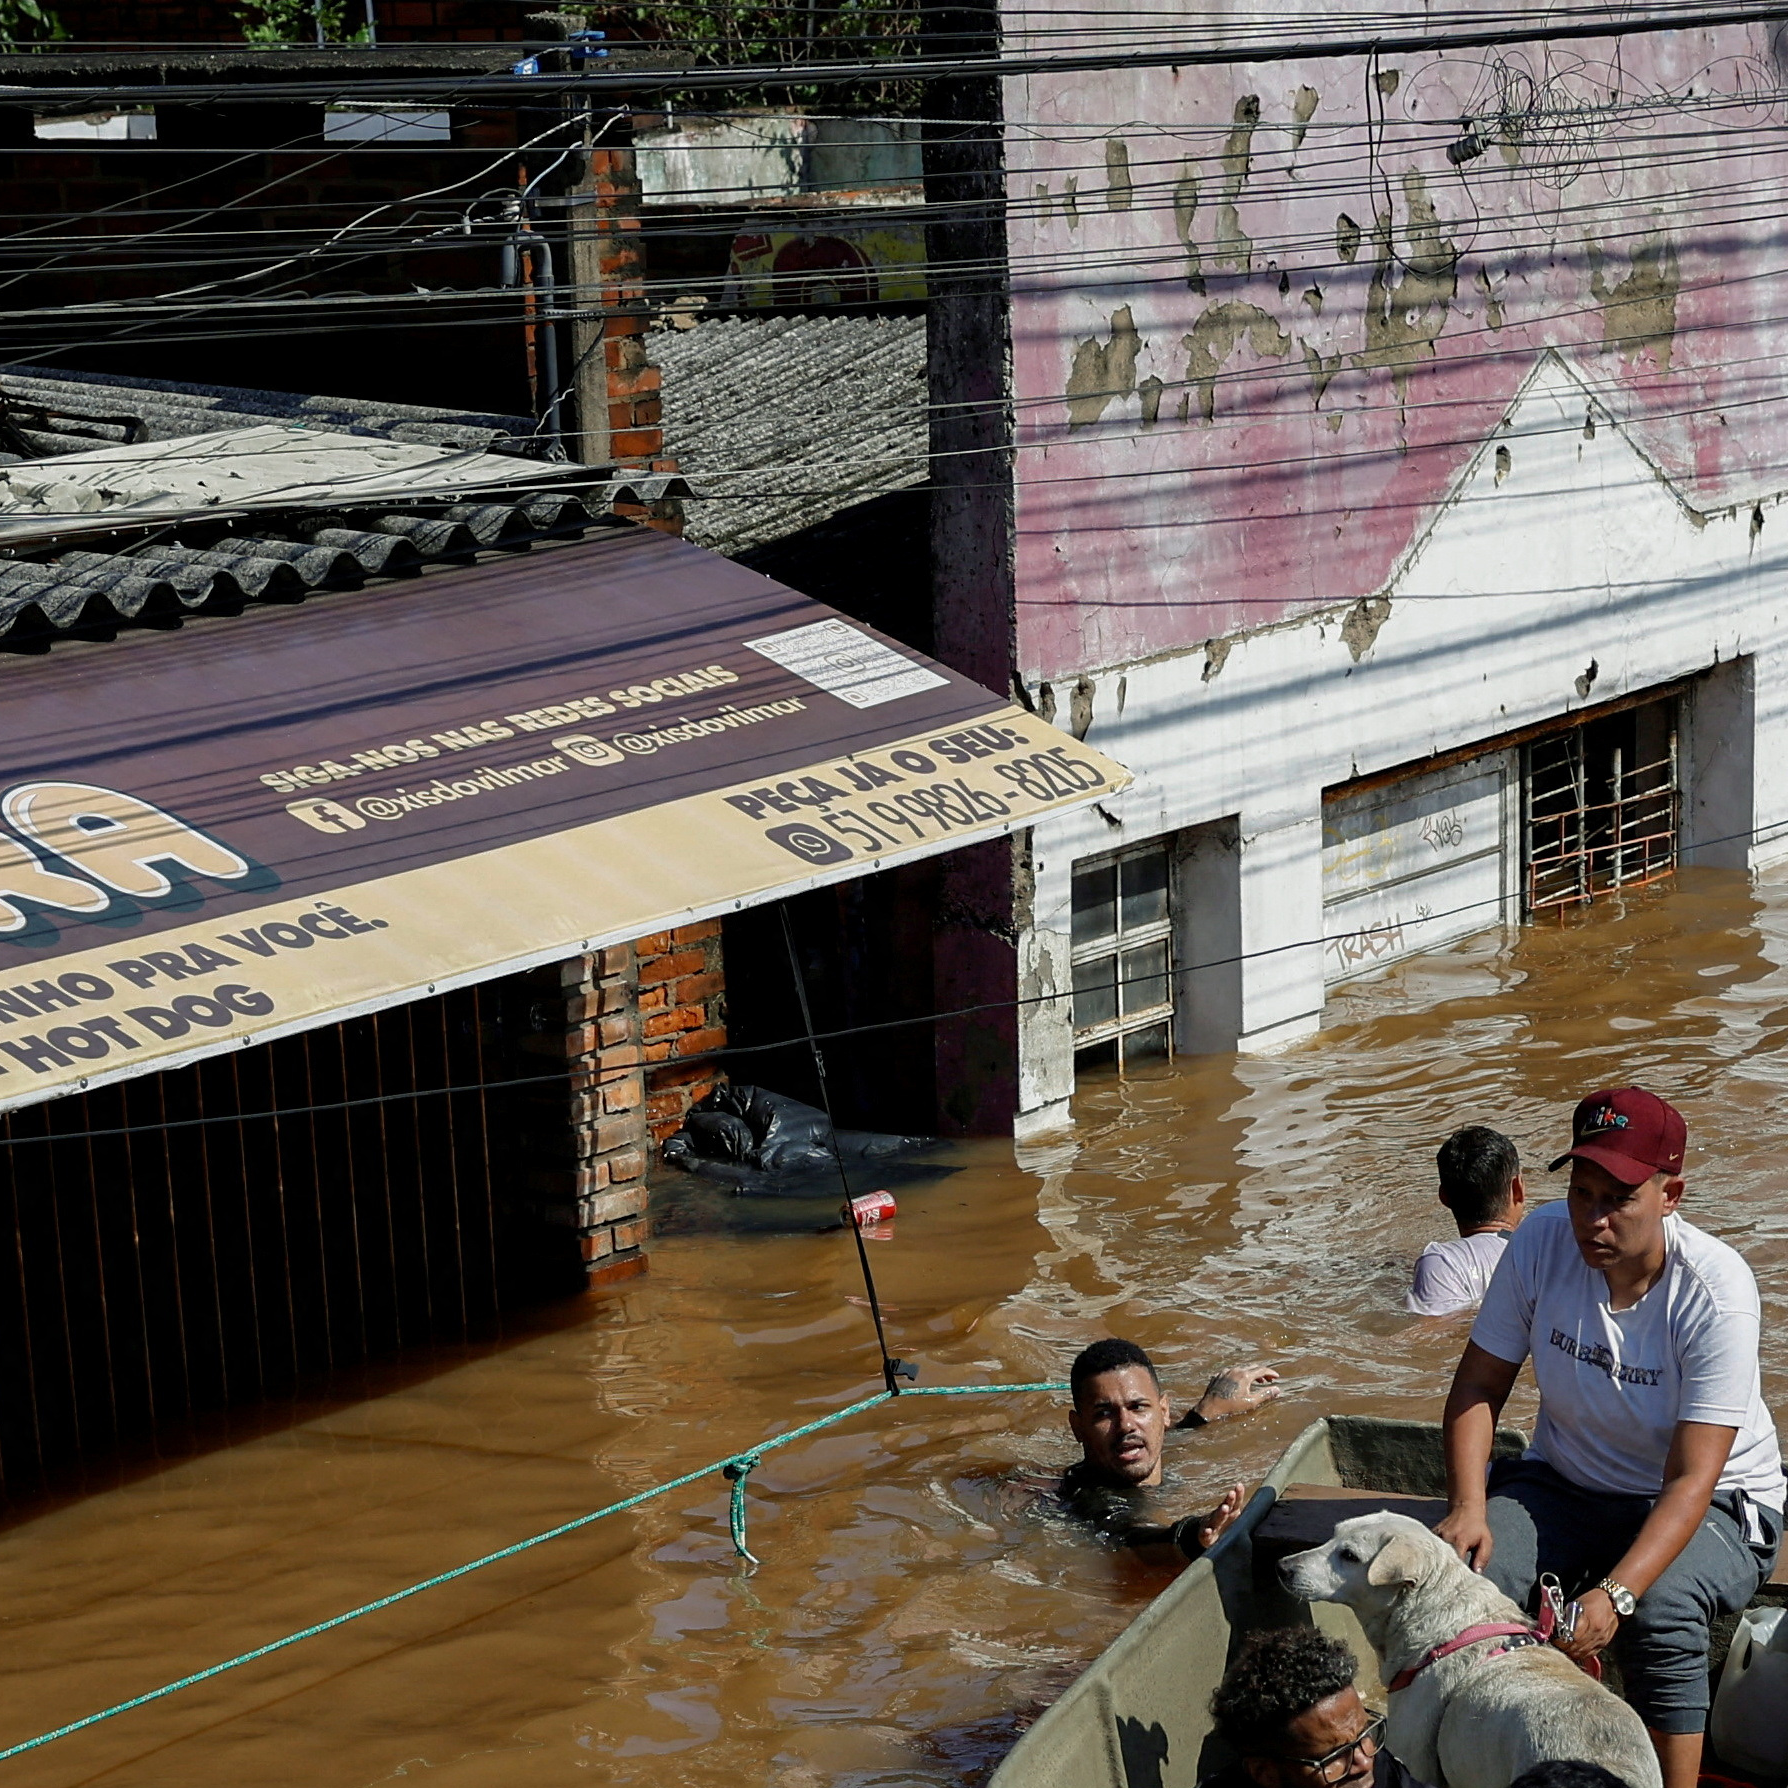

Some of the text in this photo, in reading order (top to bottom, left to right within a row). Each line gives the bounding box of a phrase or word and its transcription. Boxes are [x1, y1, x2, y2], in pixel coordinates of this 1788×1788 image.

[259, 665, 740, 793] SIGA-NOS NAS REDES SOCIAIS
[613, 695, 808, 755] @xisdovilmar
[356, 755, 571, 821] @xisdovilmar
[723, 776, 853, 821] PEÇA
[890, 750, 938, 774] O
[927, 724, 1030, 764] SEU:
[820, 809, 903, 852] 51
[993, 746, 1106, 801] 8205
[104, 942, 227, 990] PRA
[215, 902, 390, 957] VOCÊ.
[138, 983, 275, 1041] DOG
